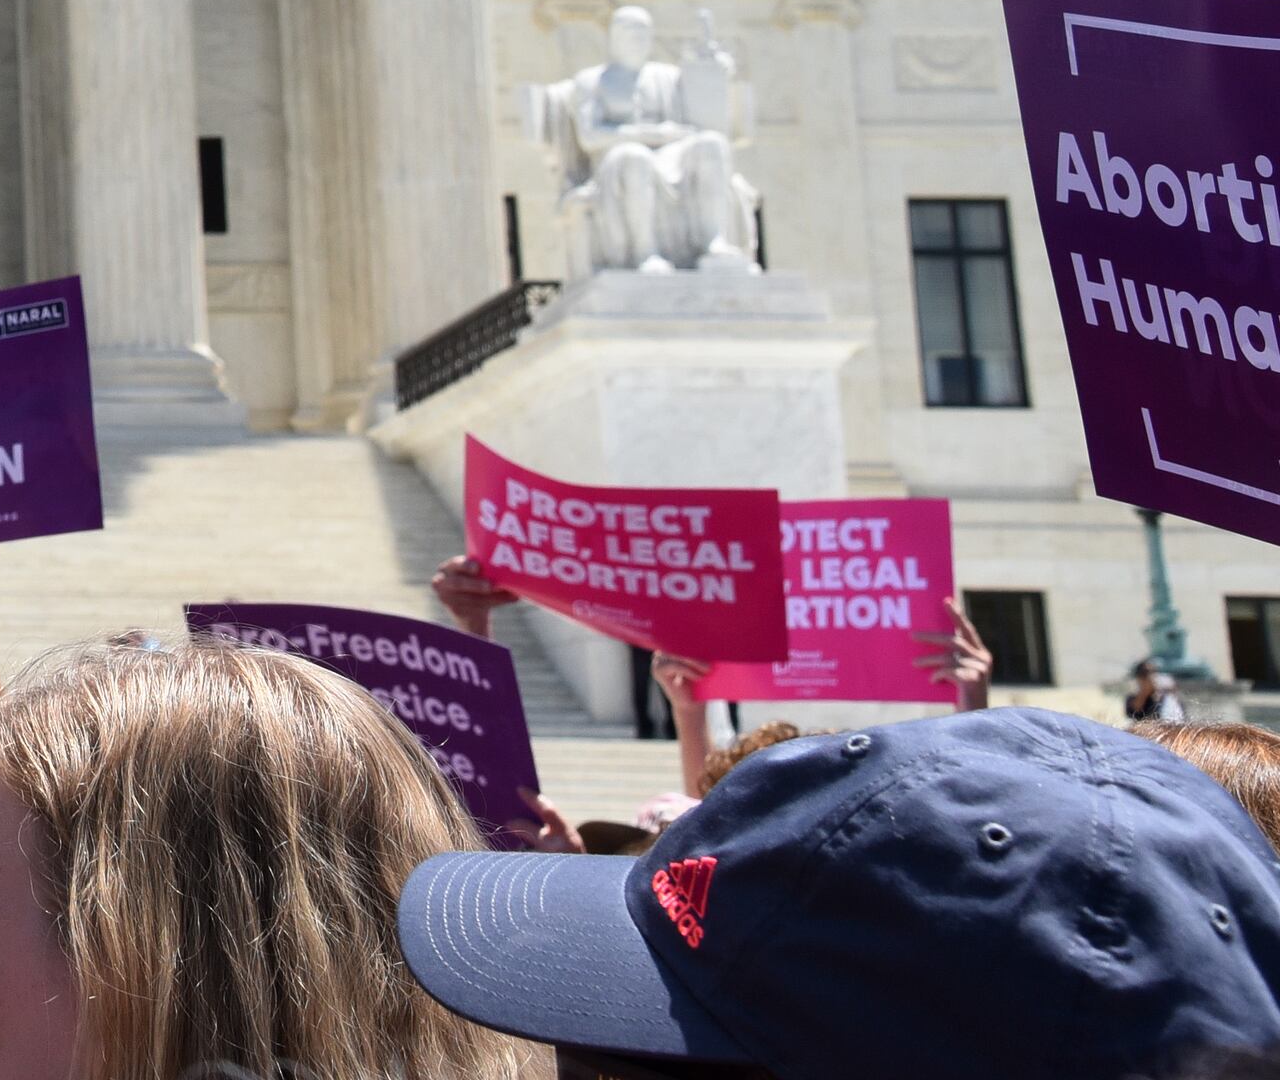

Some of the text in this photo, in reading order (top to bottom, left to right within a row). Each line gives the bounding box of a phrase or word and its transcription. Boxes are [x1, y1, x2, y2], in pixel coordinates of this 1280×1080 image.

[1055, 130, 1280, 248] Aborti
[6, 305, 62, 326] NARAL
[1070, 251, 1280, 374] Huma
[479, 498, 755, 571] SAFE, LEGAL
[506, 478, 711, 535] PROTECT
[490, 541, 737, 604] ABORTION
[801, 556, 928, 591] LEGAL
[652, 869, 704, 949] adidas
